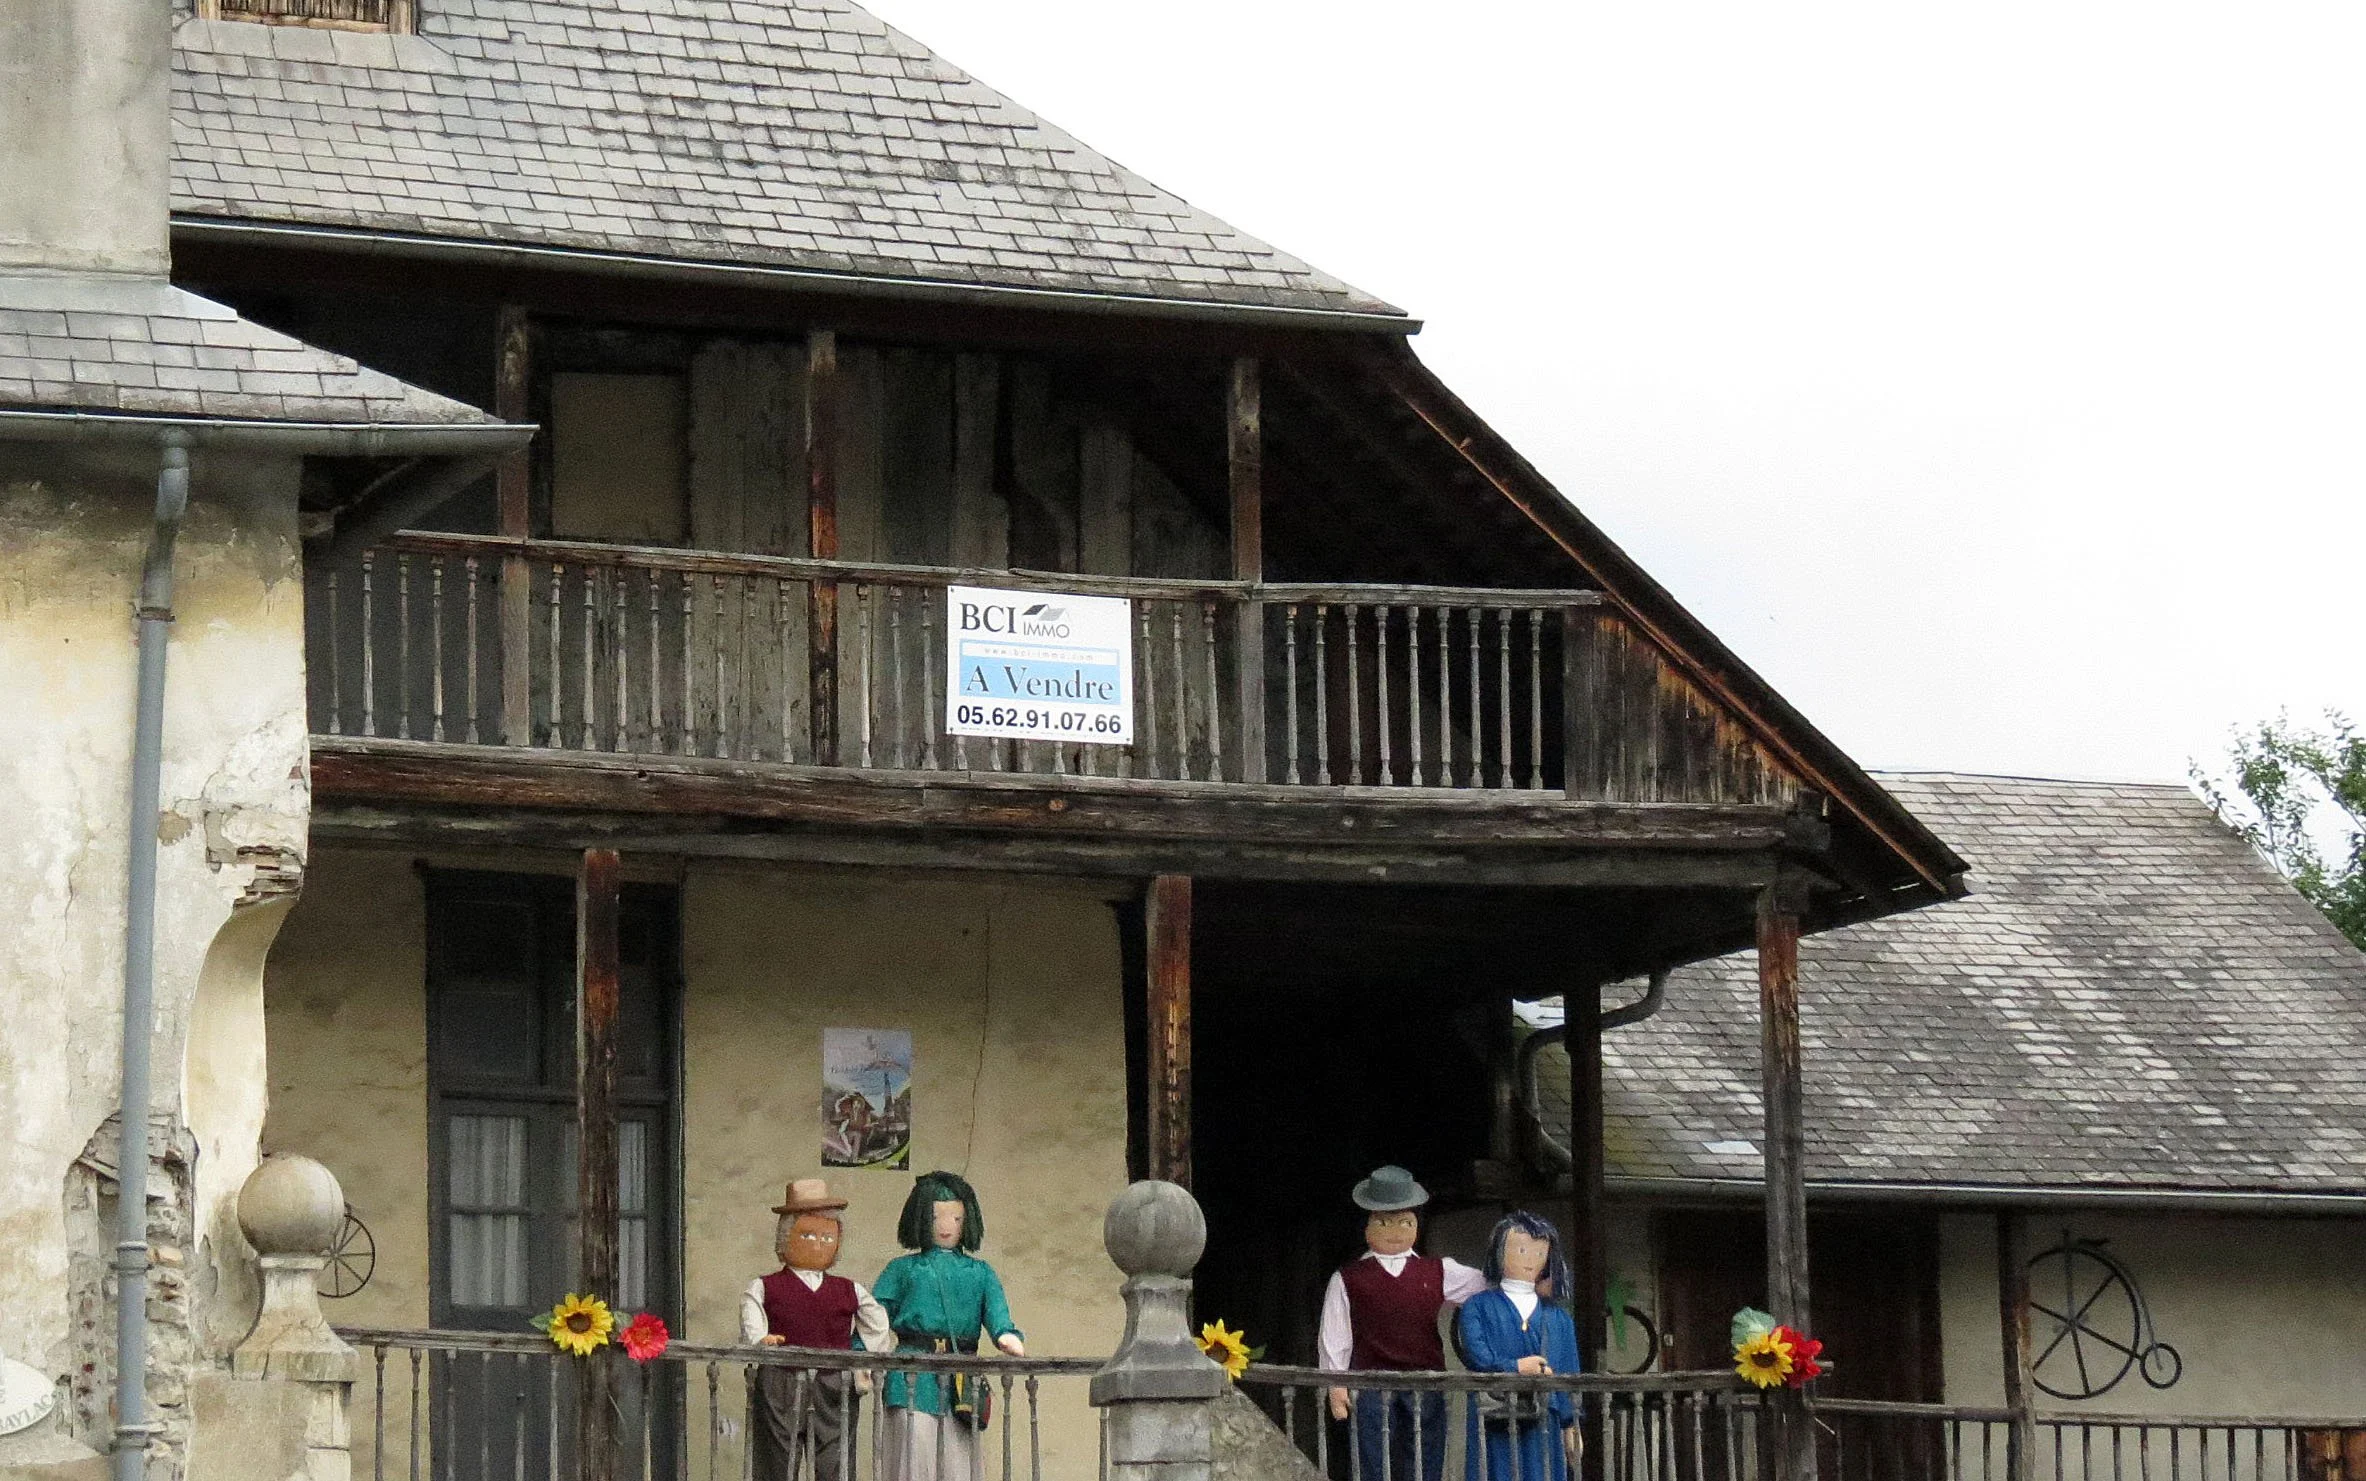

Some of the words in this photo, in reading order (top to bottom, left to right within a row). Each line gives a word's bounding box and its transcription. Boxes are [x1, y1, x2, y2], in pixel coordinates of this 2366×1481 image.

[960, 602, 1017, 634] BCI
[1023, 622, 1070, 638] IMMO
[966, 664, 989, 693] A
[1003, 666, 1114, 700] Vendre
[957, 705, 1122, 734] 05.62.91.07.66
